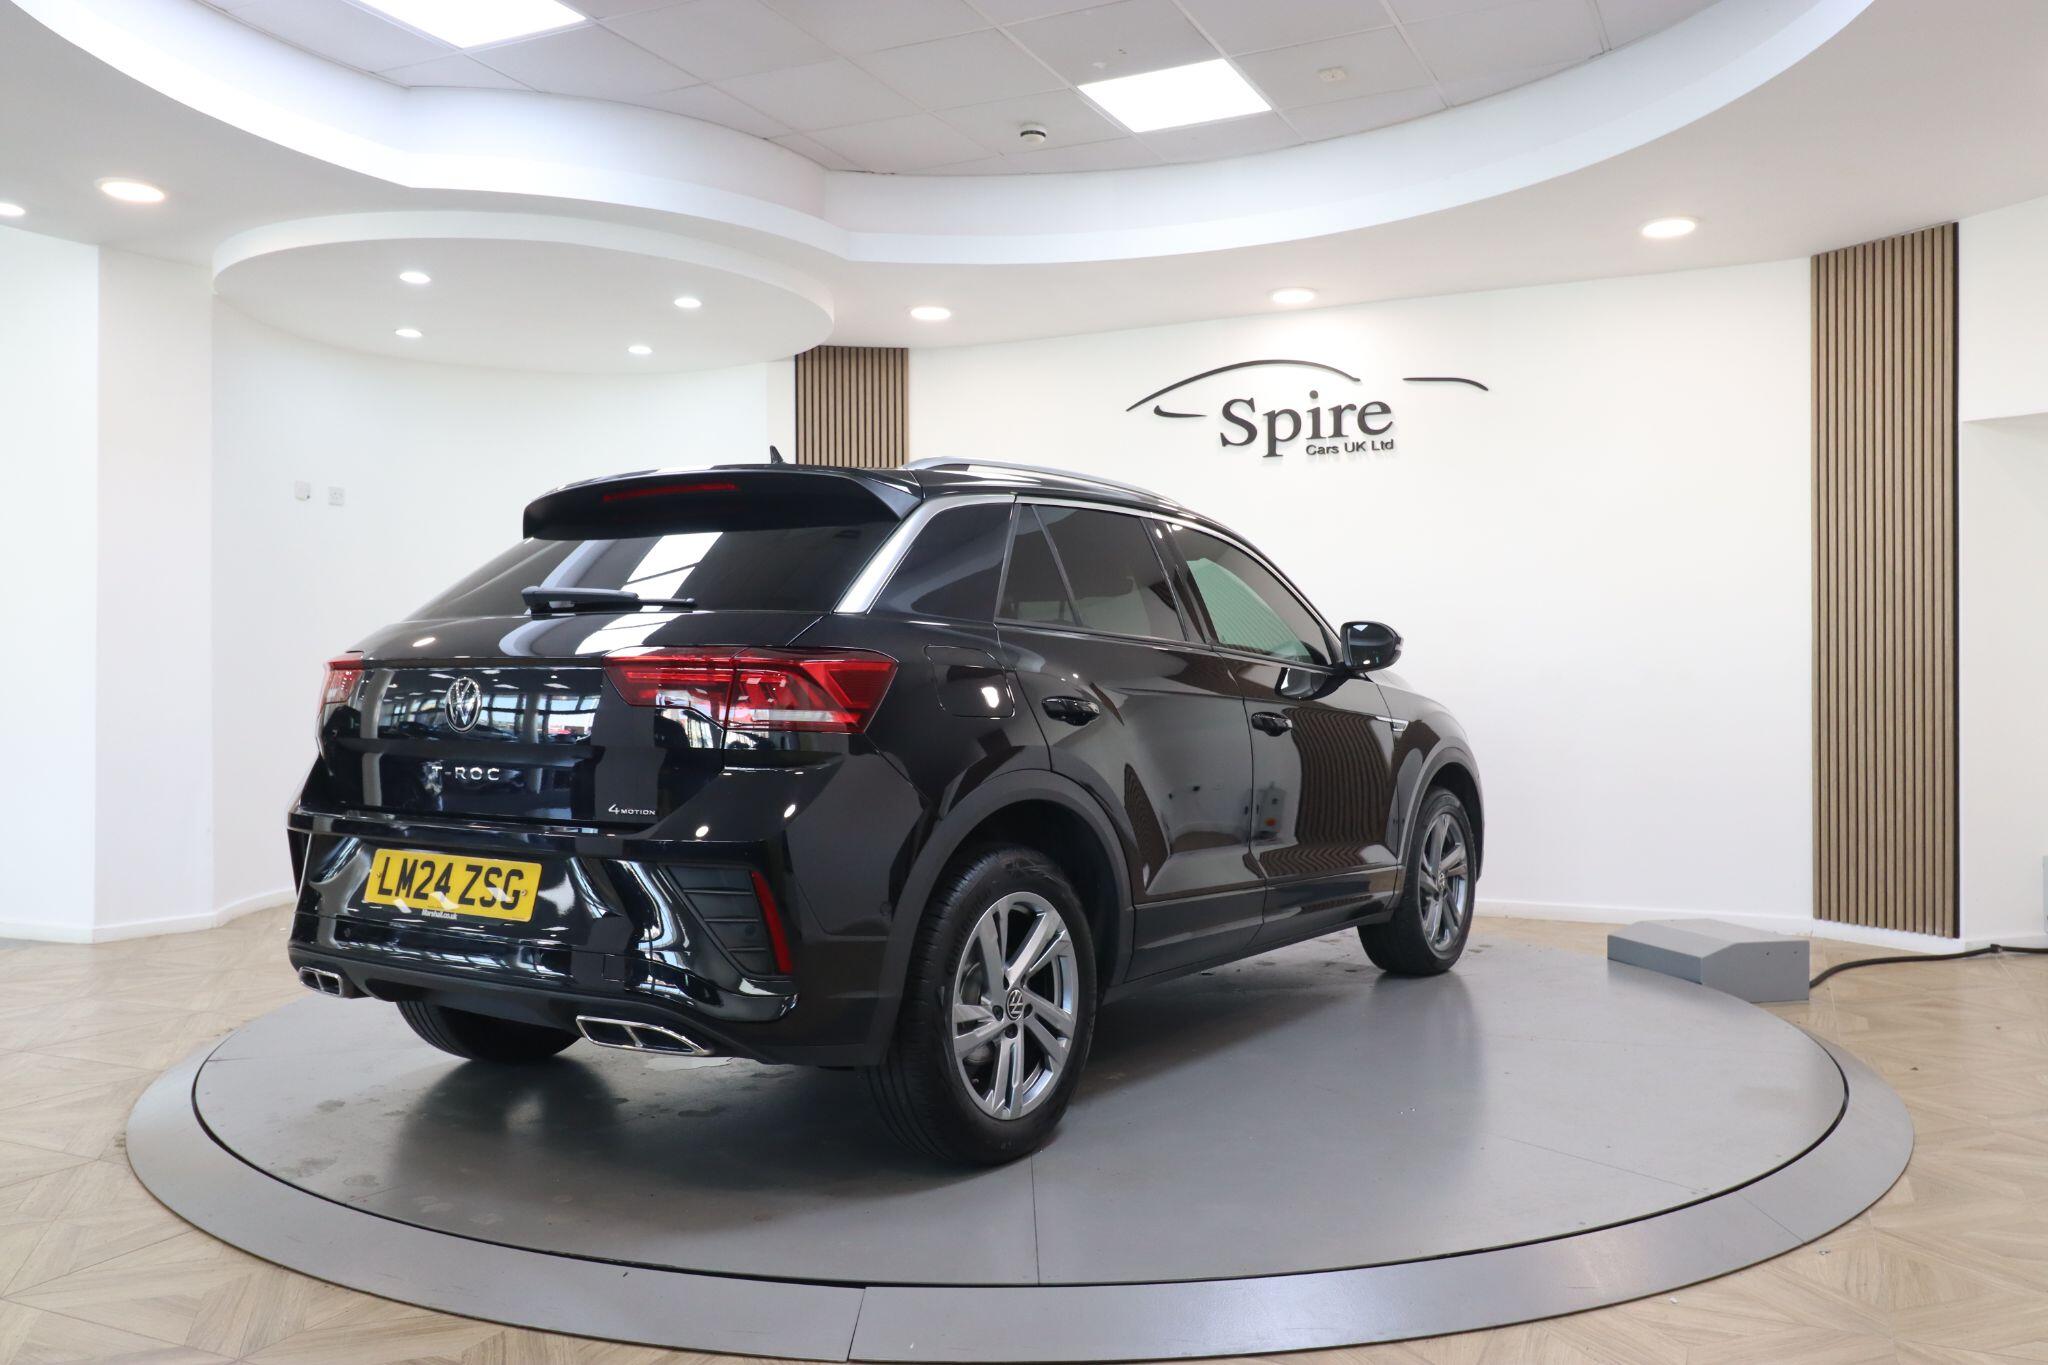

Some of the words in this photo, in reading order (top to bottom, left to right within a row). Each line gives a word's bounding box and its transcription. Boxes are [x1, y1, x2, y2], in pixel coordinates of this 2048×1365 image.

[1219, 390, 1394, 458] Spire
[1305, 444, 1340, 456] Cars
[1344, 441, 1367, 453] UK
[1371, 438, 1395, 451] Ltd
[431, 766, 500, 781] T-ROC
[608, 803, 656, 815] 4MOTION
[377, 856, 454, 901] LM24
[458, 863, 525, 911] ZSG
